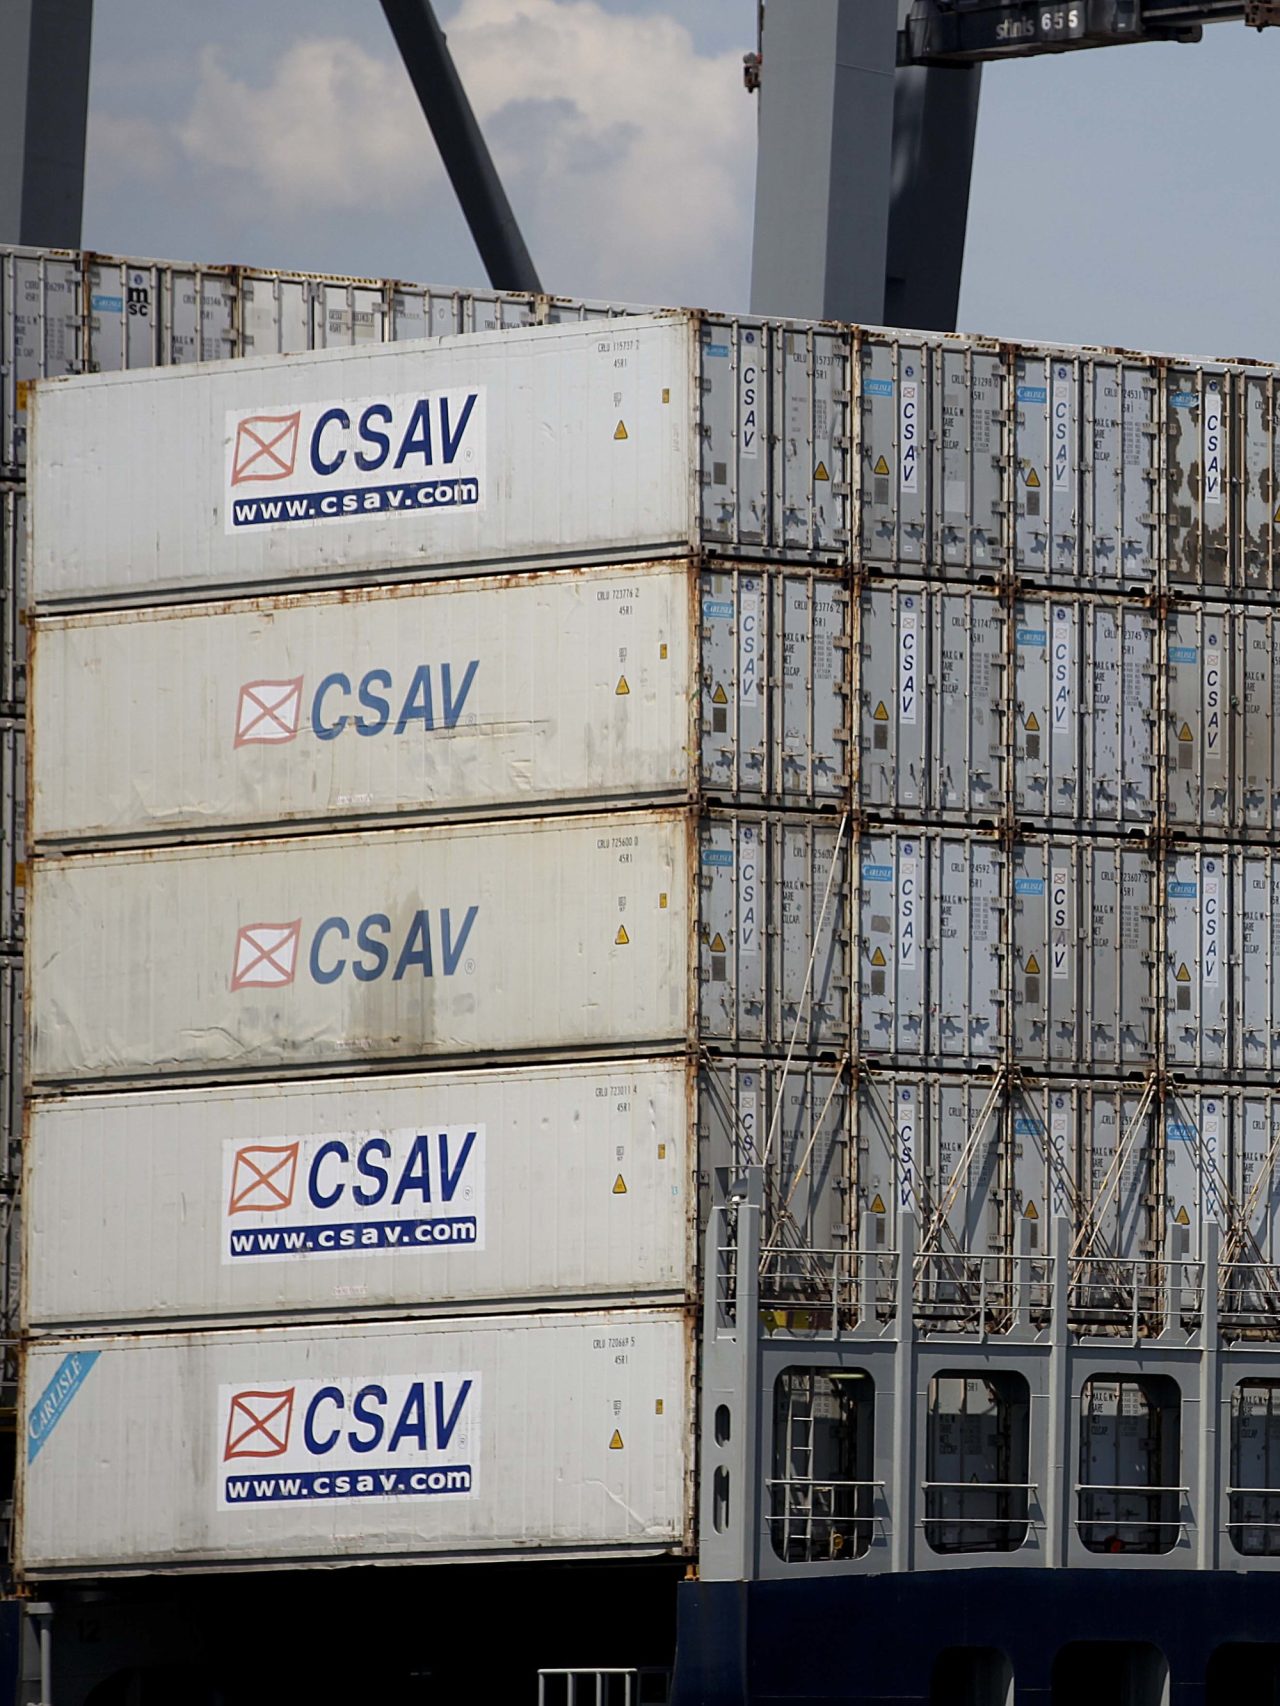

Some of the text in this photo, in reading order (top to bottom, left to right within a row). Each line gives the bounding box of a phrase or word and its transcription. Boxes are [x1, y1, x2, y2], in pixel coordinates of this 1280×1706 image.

[996, 19, 1034, 40] stinis
[310, 393, 478, 476] CSAV
[744, 367, 755, 447] CSAV
[903, 402, 915, 482] CSAV
[1055, 403, 1067, 481] CSAV
[1207, 415, 1218, 493] CSAV
[235, 480, 477, 523] www.csav.com
[743, 616, 755, 696] CSAV
[903, 634, 914, 713] CSAV
[1055, 644, 1067, 723] CSAV
[311, 659, 480, 741] CSAV
[1207, 670, 1219, 749] CSAV
[743, 864, 754, 944] CSAV
[902, 879, 913, 959] CSAV
[1054, 889, 1066, 968] CSAV
[1205, 899, 1217, 977] CSAV
[309, 904, 479, 985] CSAV
[309, 1132, 477, 1210] CSAV
[232, 1219, 475, 1253] www.csav.com
[29, 1355, 81, 1439] CARLISLE
[303, 1379, 471, 1456] CSAV
[228, 1467, 470, 1500] www.csav.com
